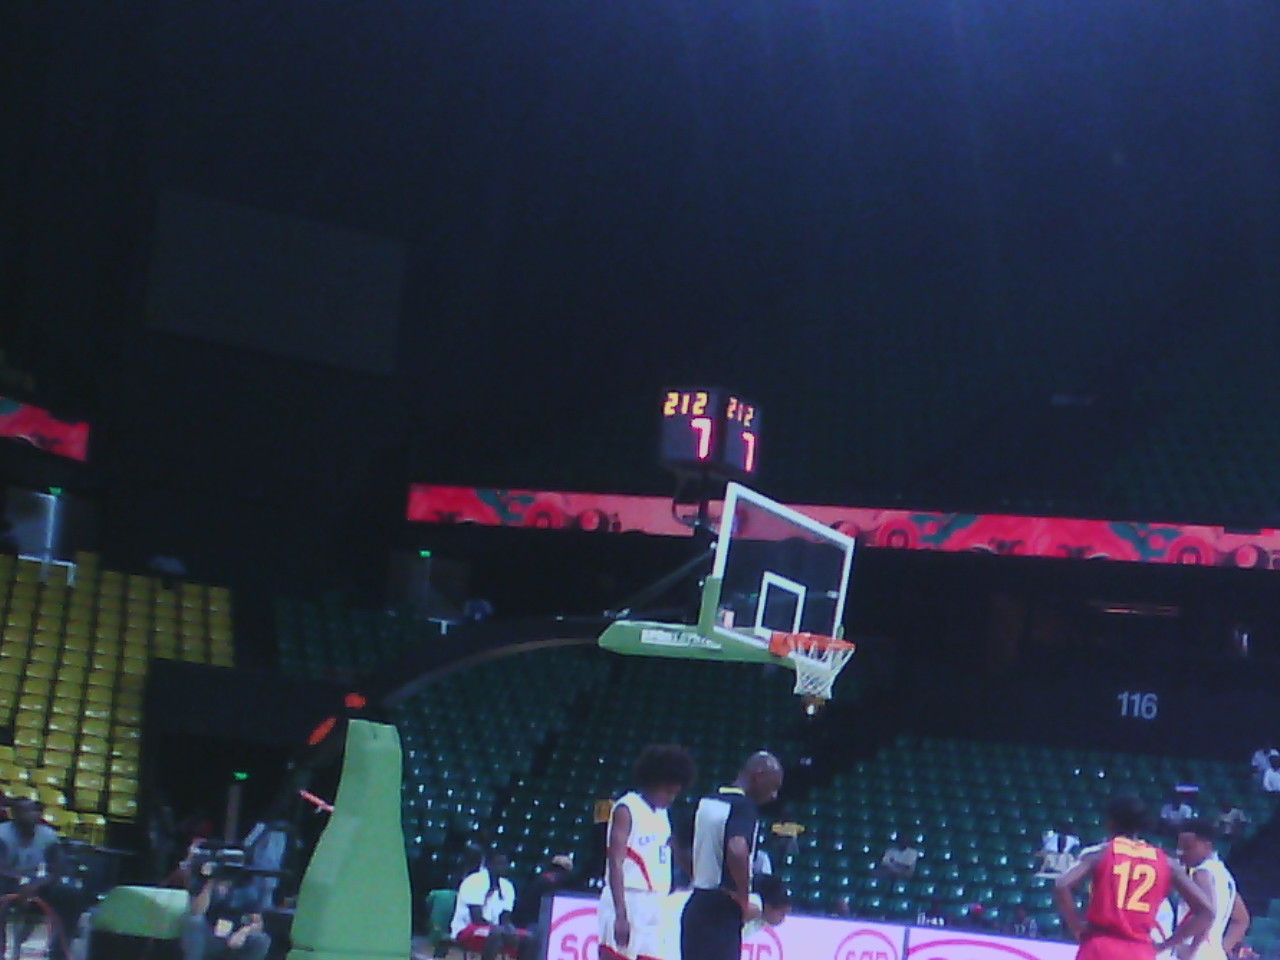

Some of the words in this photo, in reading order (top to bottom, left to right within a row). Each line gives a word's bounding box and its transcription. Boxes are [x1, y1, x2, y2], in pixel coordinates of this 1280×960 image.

[664, 392, 707, 415] 212
[727, 397, 754, 427] 212
[691, 418, 711, 459] 7
[743, 432, 755, 471] 7
[1118, 691, 1157, 719] 116
[1113, 861, 1156, 912] 12
